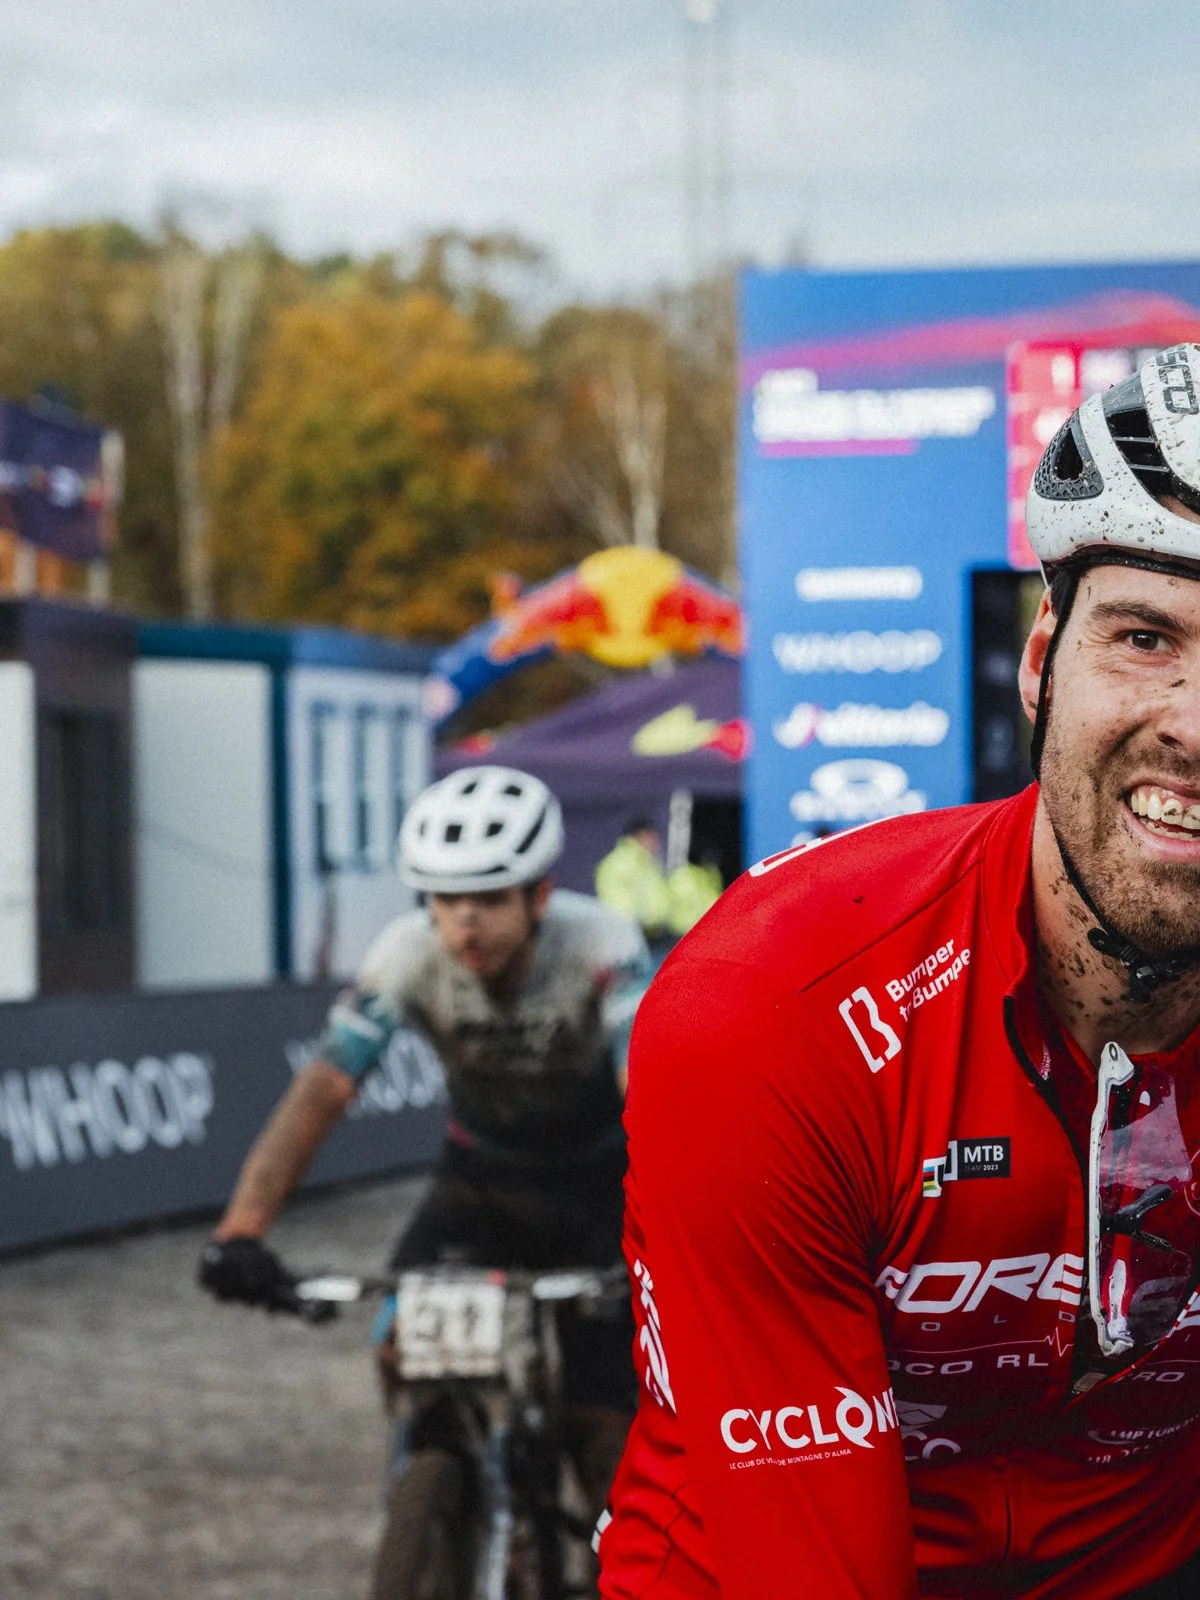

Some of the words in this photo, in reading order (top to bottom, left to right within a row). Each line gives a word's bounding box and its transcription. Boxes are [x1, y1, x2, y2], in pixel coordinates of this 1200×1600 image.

[885, 939, 954, 1002] Bumper
[913, 948, 971, 1008] Bumpe
[0, 1053, 213, 1169] WHOOP
[964, 1145, 1004, 1163] MTB
[997, 1353, 1049, 1369] RL
[737, 1459, 755, 1469] CLUB
[756, 1458, 765, 1466] DE
[787, 1453, 823, 1465] MONTAGNE
[824, 1448, 852, 1459] D'ALMA
